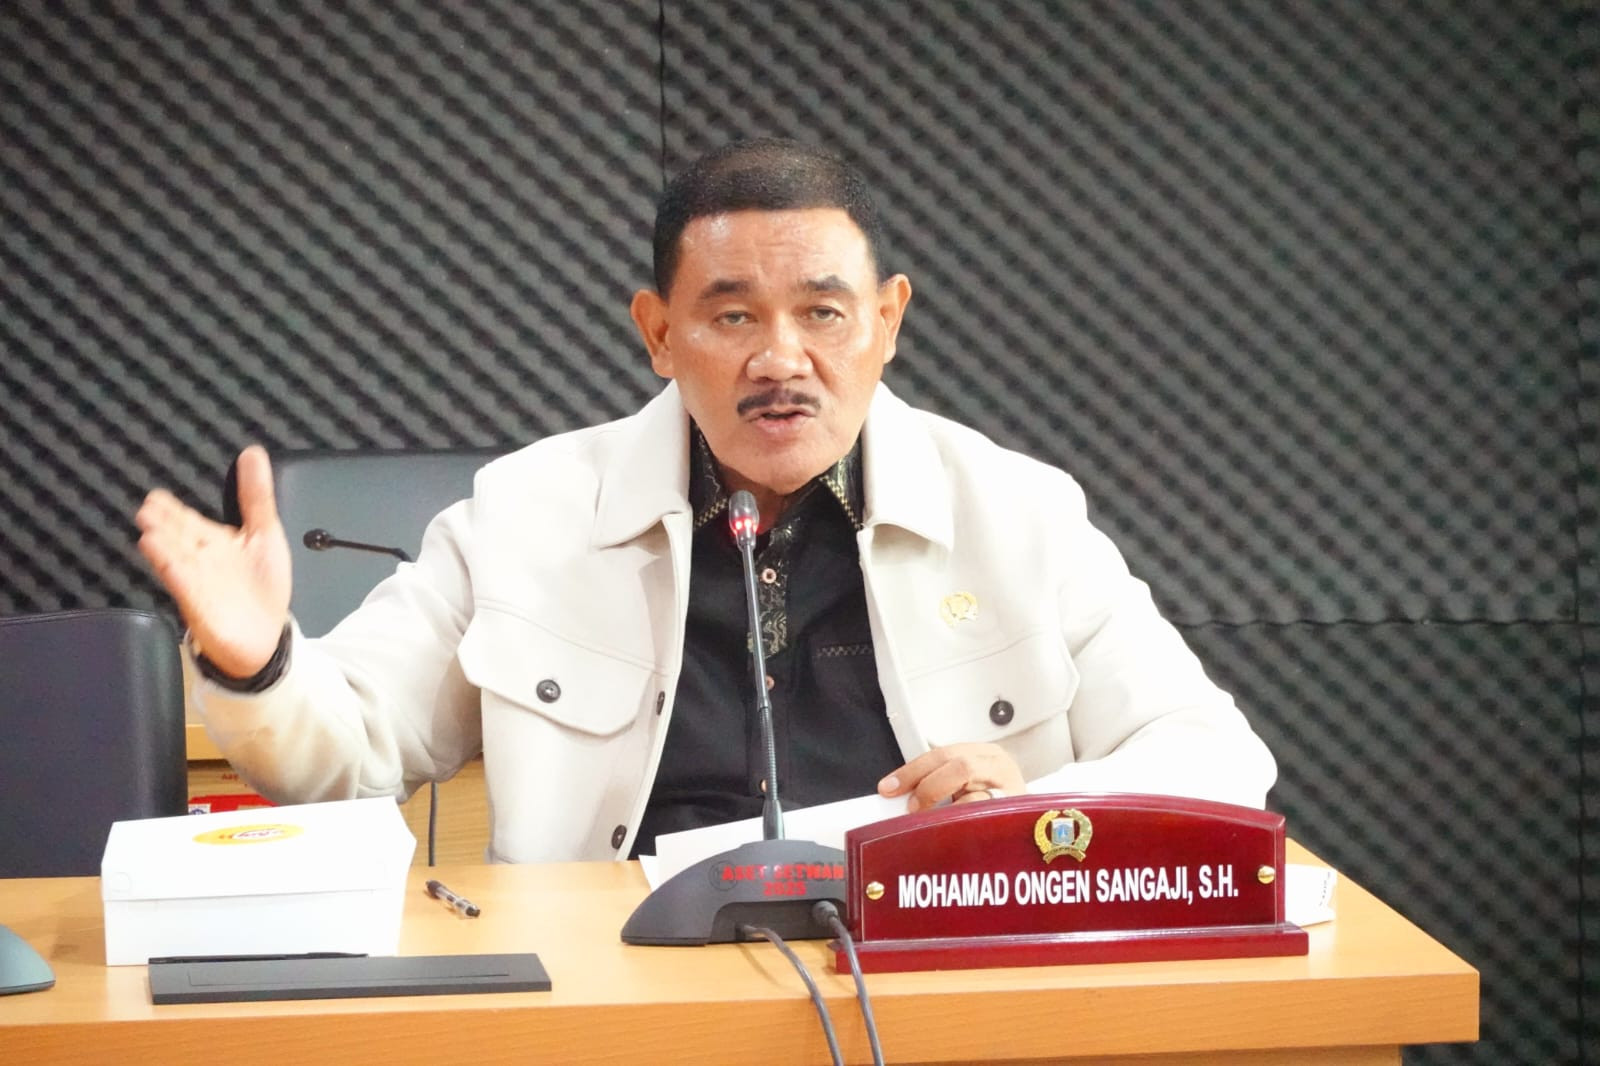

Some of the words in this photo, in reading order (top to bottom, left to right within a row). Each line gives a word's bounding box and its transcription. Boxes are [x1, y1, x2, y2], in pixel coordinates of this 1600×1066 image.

[763, 882, 807, 896] 2025
[899, 873, 1009, 908] MOHAMAD
[1014, 870, 1090, 905] ONGEN
[1096, 866, 1193, 904] SANGAJI,
[1199, 865, 1239, 898] S.H.
